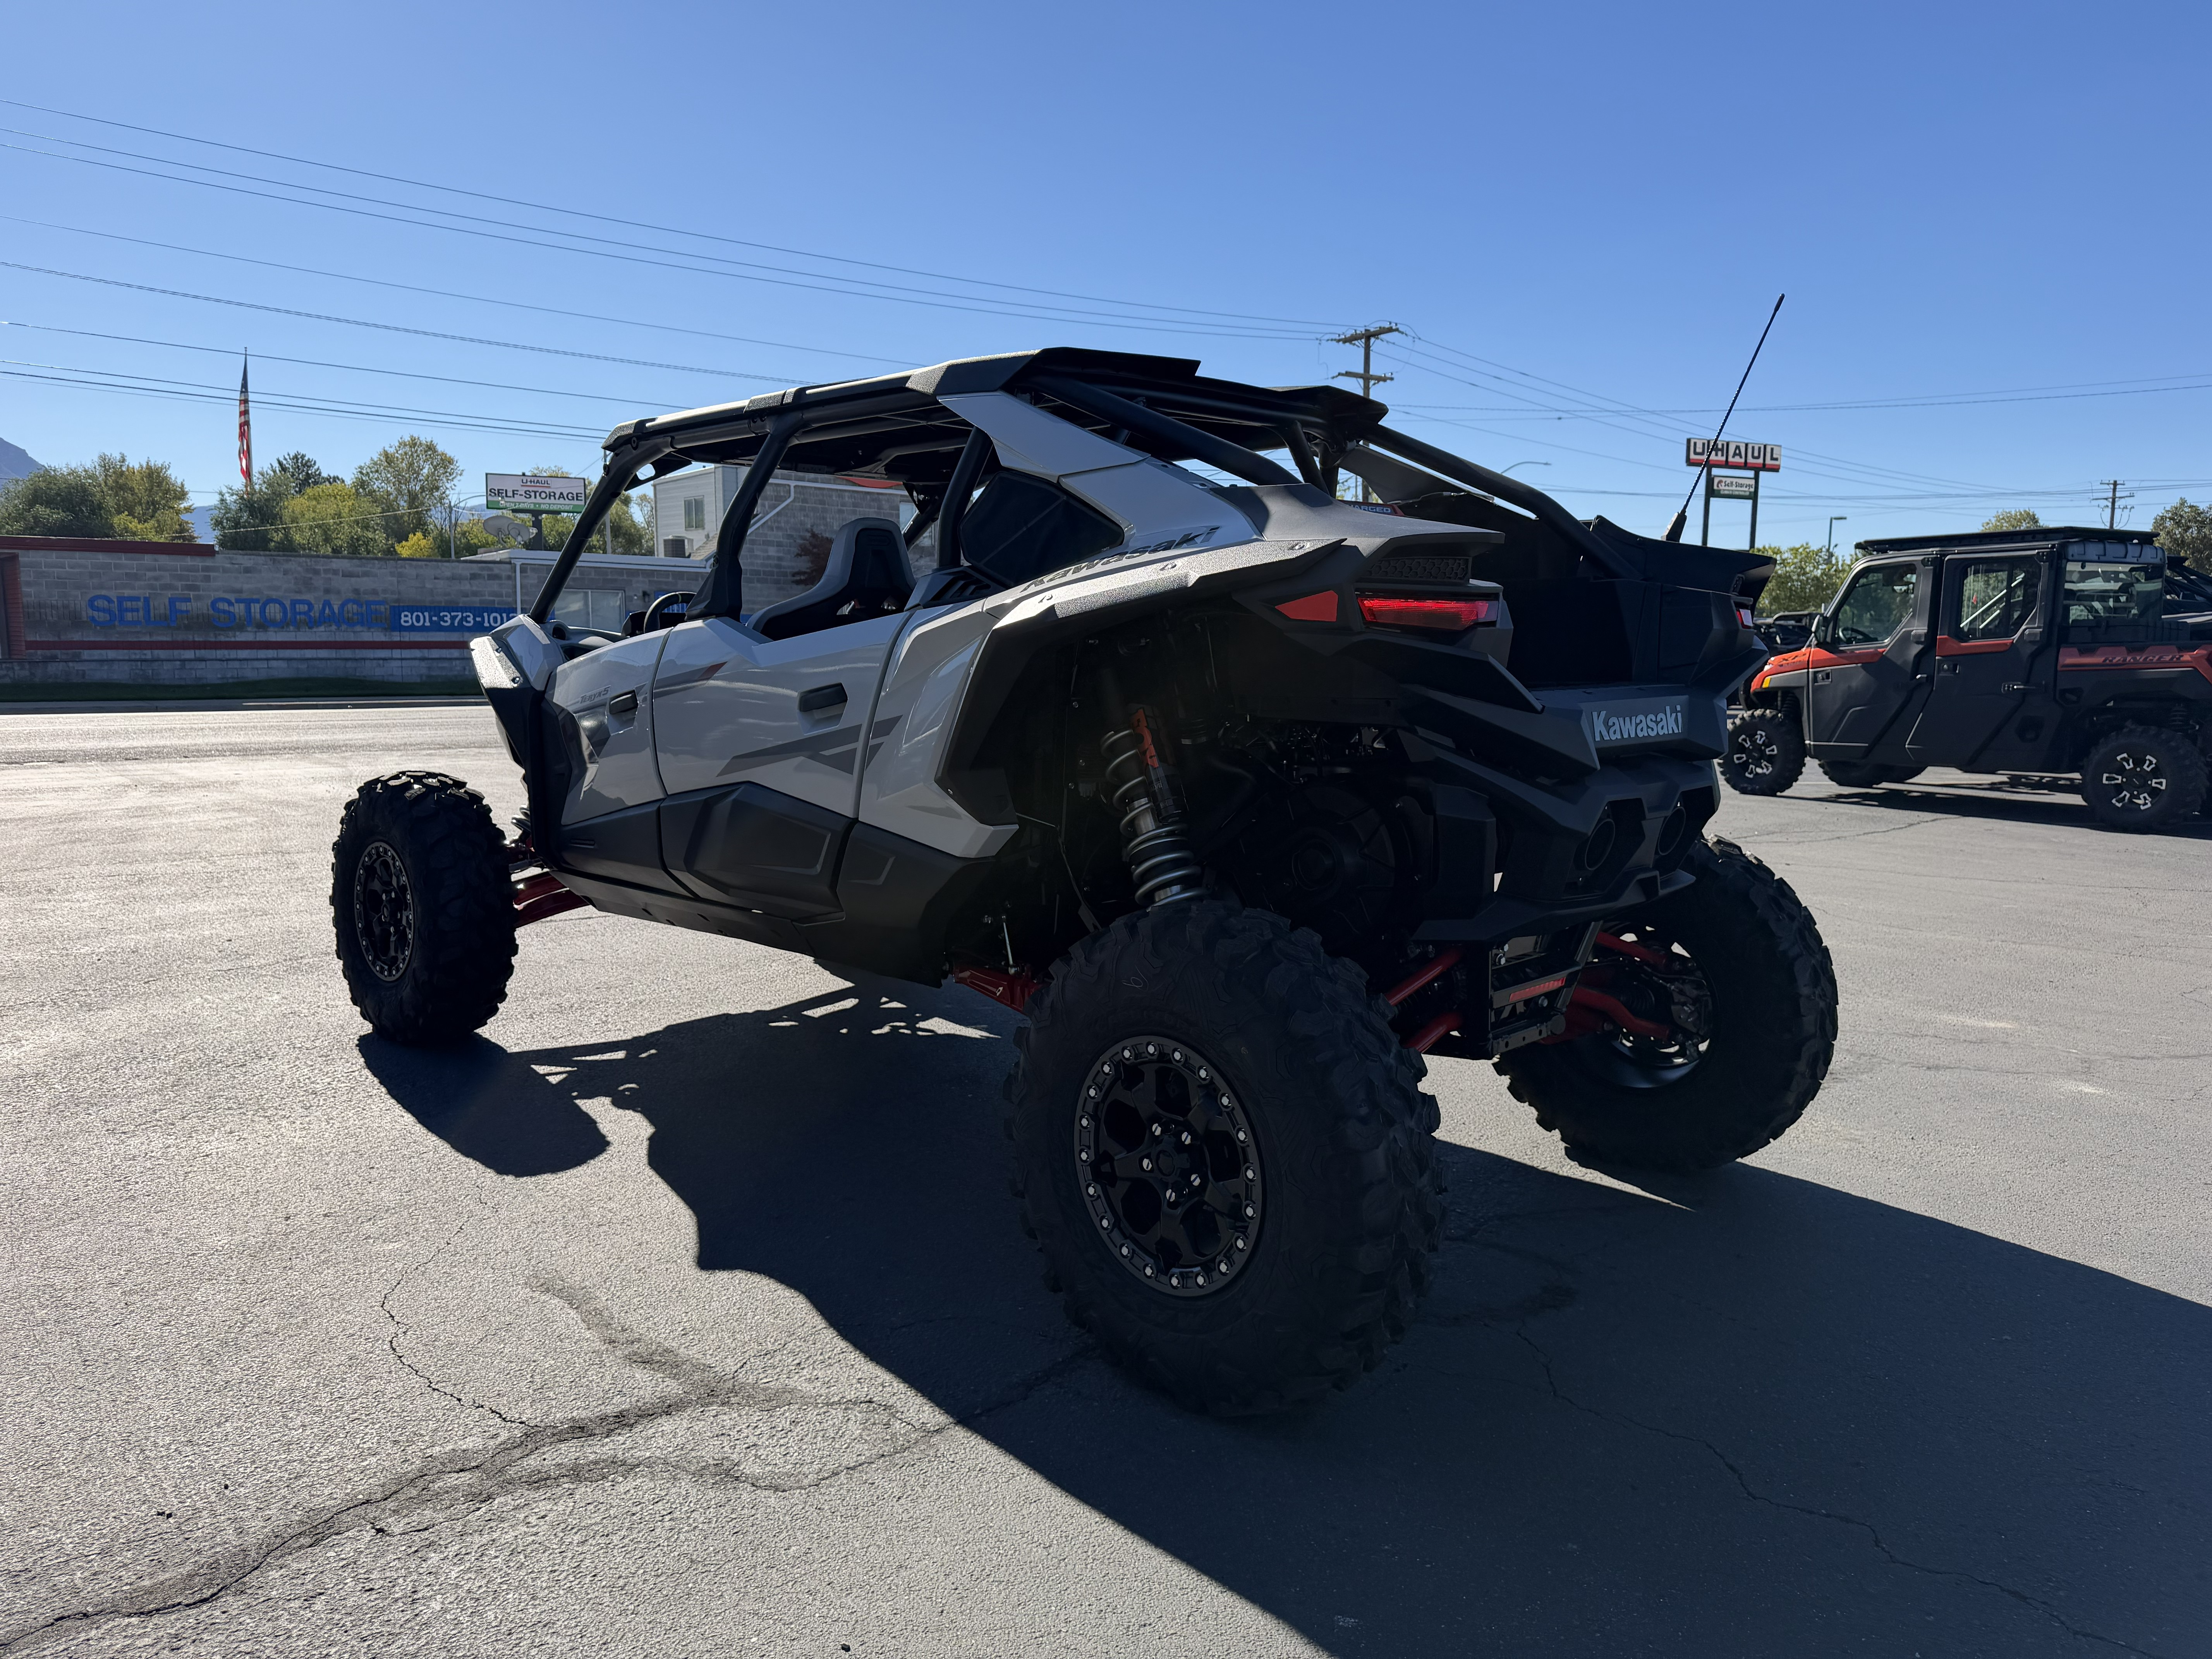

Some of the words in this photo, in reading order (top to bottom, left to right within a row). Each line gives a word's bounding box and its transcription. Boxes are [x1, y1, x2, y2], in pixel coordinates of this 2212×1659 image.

[1724, 481, 1753, 489] Self-Storage
[488, 488, 583, 501] SELF-STORAGE
[1019, 526, 1220, 593] Kawasaki
[88, 594, 192, 627] SELF
[210, 597, 386, 628] STORAGE
[401, 611, 518, 627] 801-373-101
[2102, 654, 2184, 663] RANGER
[1592, 705, 1683, 741] Kawasaki
